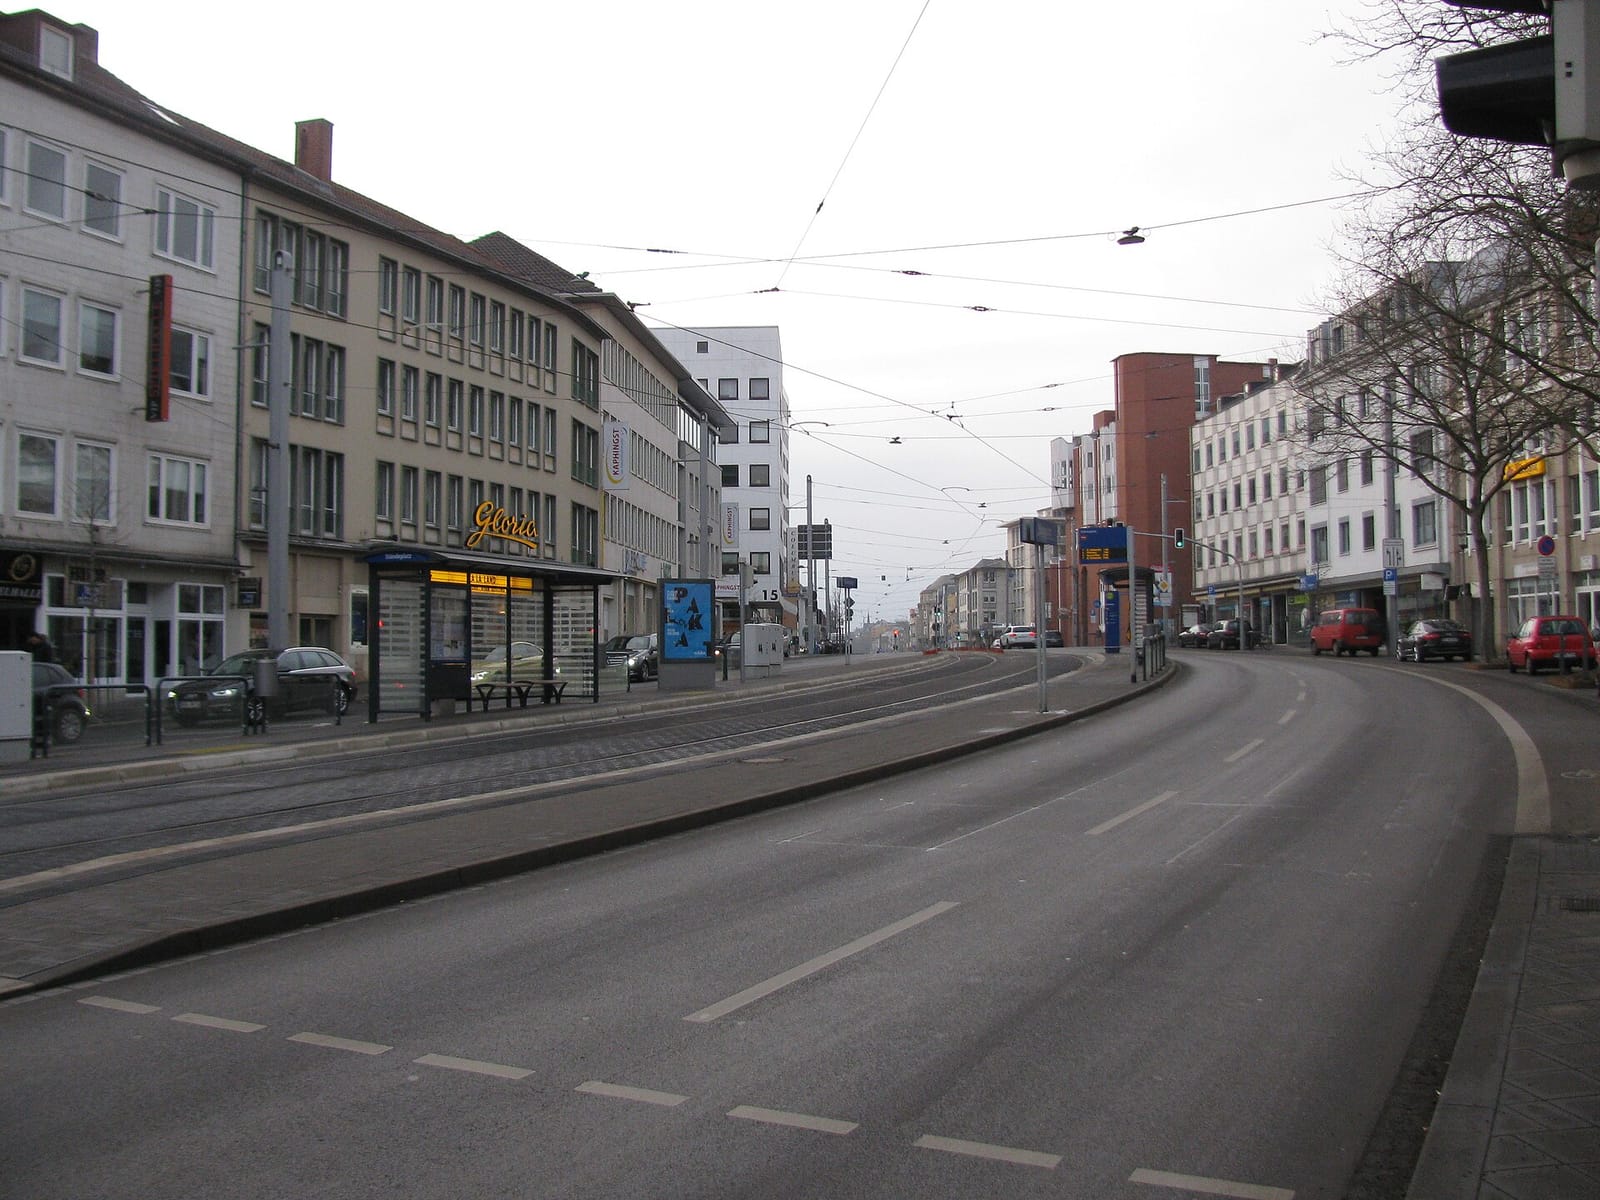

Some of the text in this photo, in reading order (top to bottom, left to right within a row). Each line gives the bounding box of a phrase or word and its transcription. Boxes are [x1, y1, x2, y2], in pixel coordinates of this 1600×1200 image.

[612, 428, 620, 476] KAPHINGST
[466, 500, 539, 549] Gloria
[762, 589, 778, 600] 15
